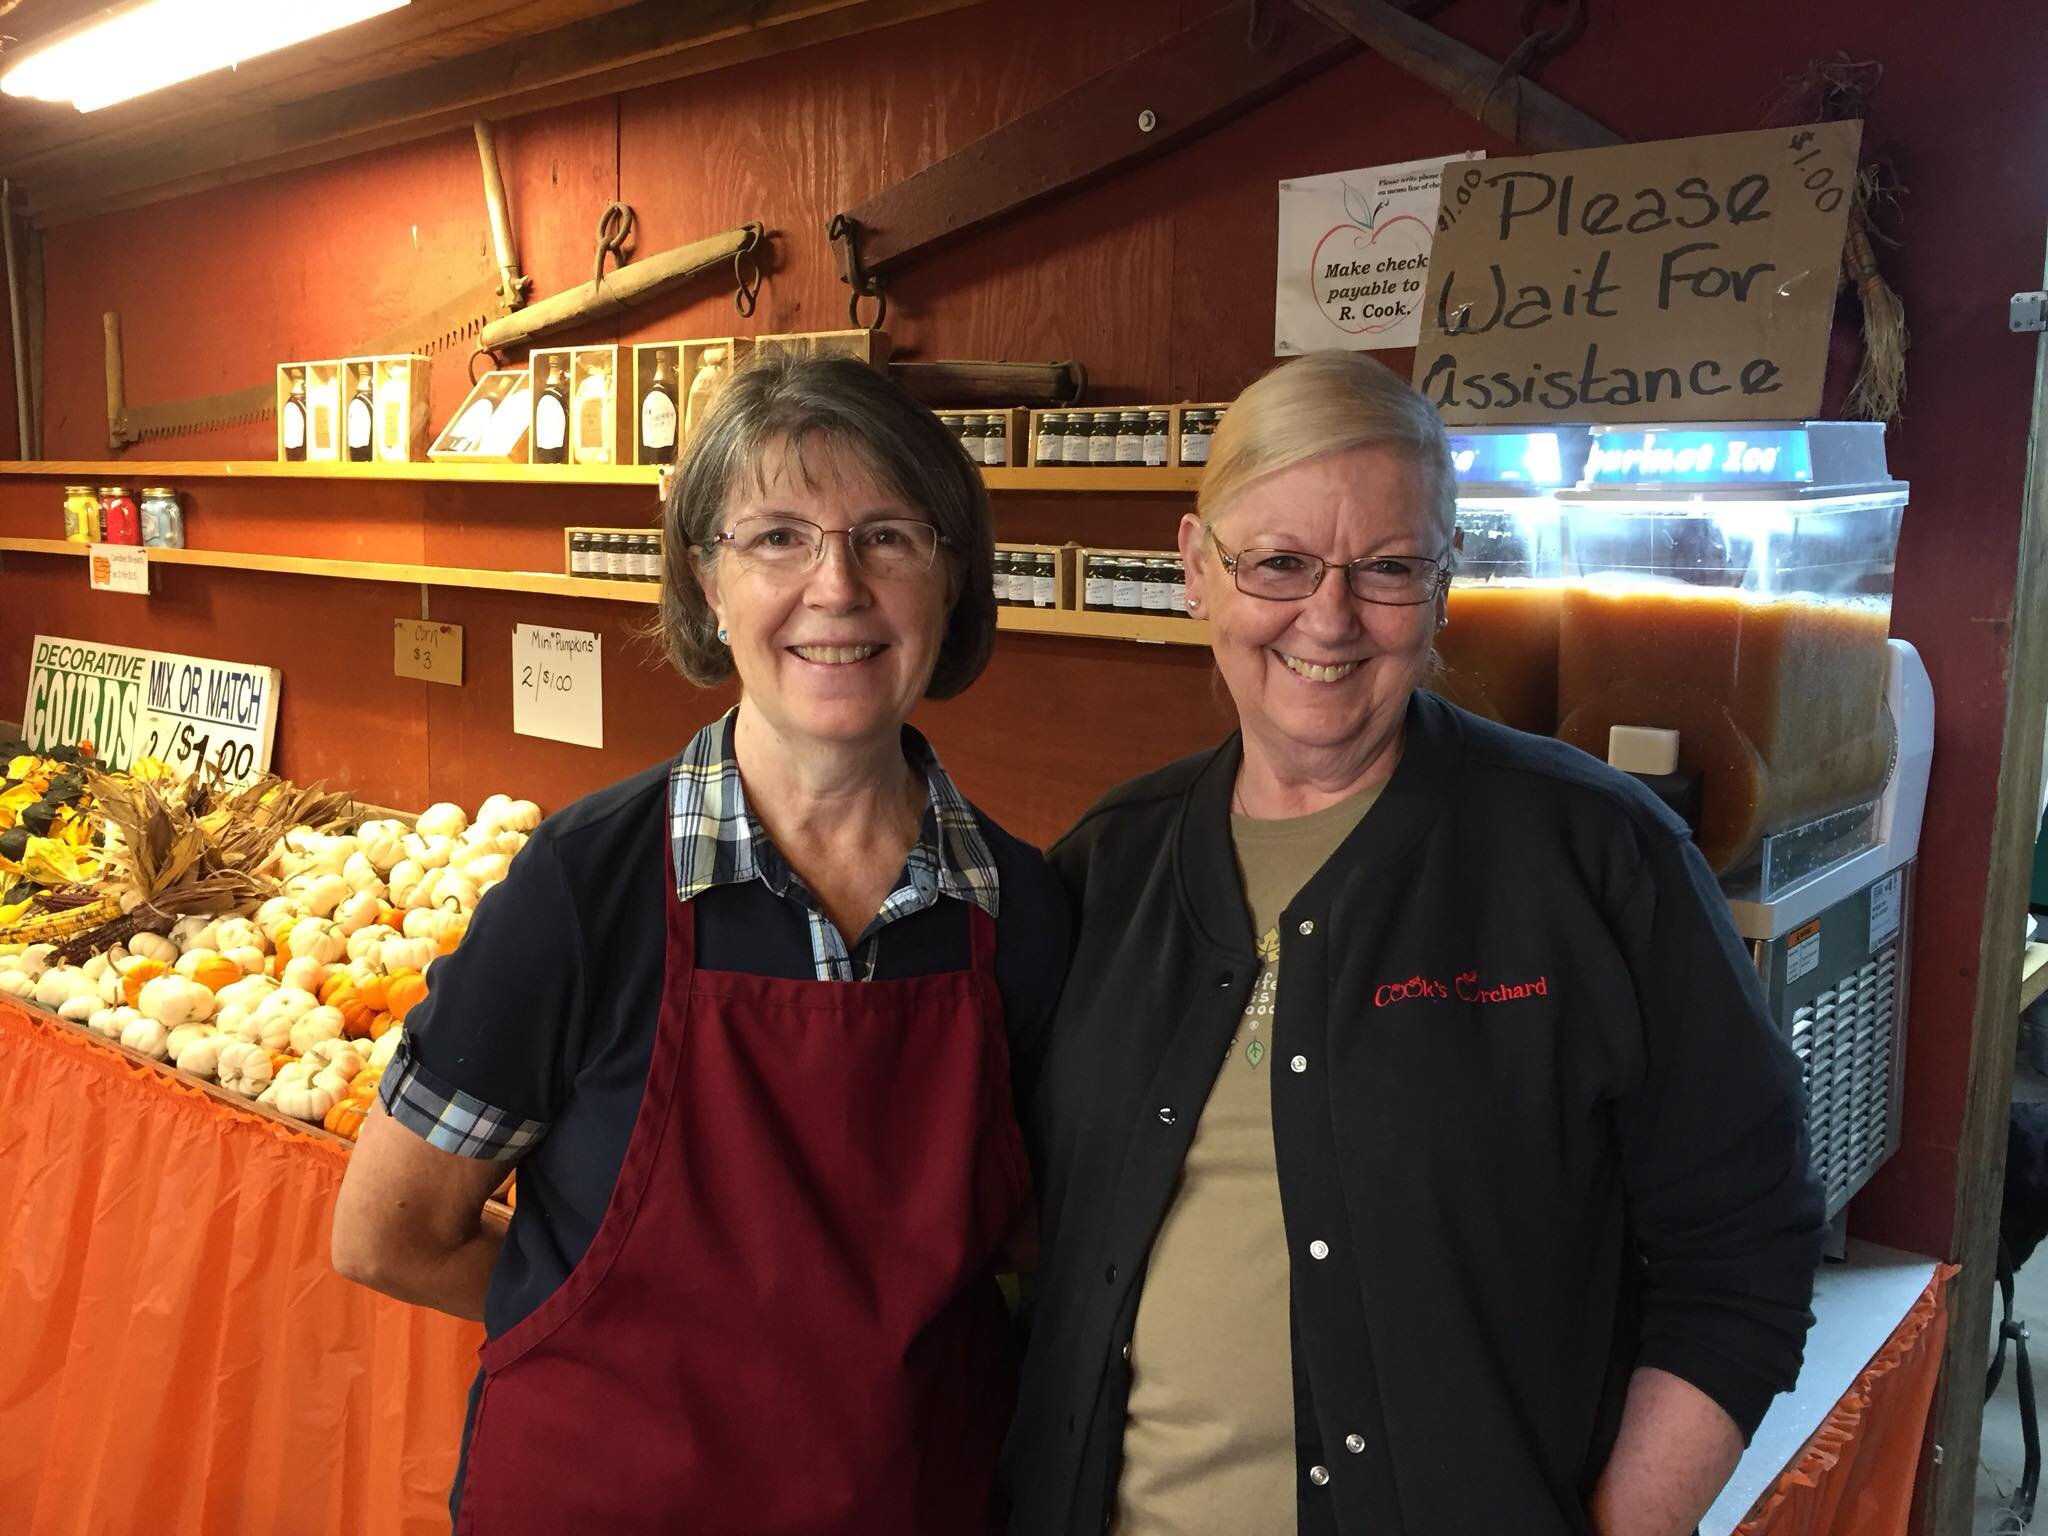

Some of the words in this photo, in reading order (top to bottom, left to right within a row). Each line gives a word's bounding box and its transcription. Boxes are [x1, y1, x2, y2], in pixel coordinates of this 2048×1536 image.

[1378, 178, 1399, 187] Please
[1418, 173, 1439, 182] phone
[1788, 131, 1845, 213] $1.00
[1407, 184, 1420, 192] line
[1421, 182, 1428, 190] of
[1437, 168, 1482, 232] $1.00
[1483, 170, 1772, 241] Please
[1324, 261, 1371, 279] Make
[1376, 253, 1429, 273] check
[1326, 280, 1397, 304] payable
[1402, 278, 1420, 293] to
[1437, 250, 1622, 337] Wait
[1657, 241, 1777, 311] For
[1339, 306, 1356, 321] R.
[1362, 300, 1412, 319] Cook.
[414, 623, 439, 649] Corn
[530, 629, 553, 649] Mini
[553, 633, 595, 662] Pumpkins
[35, 642, 147, 681] DECORATIVE
[412, 648, 433, 670] $3
[147, 659, 177, 710] MIX
[178, 663, 204, 714] OR
[205, 668, 265, 725] MATCH
[27, 666, 141, 772] GOURDS
[1253, 971, 1278, 991] ife
[1373, 973, 1449, 1008] Cook's
[1454, 968, 1549, 1004] Orchard
[1249, 990, 1271, 1004] is
